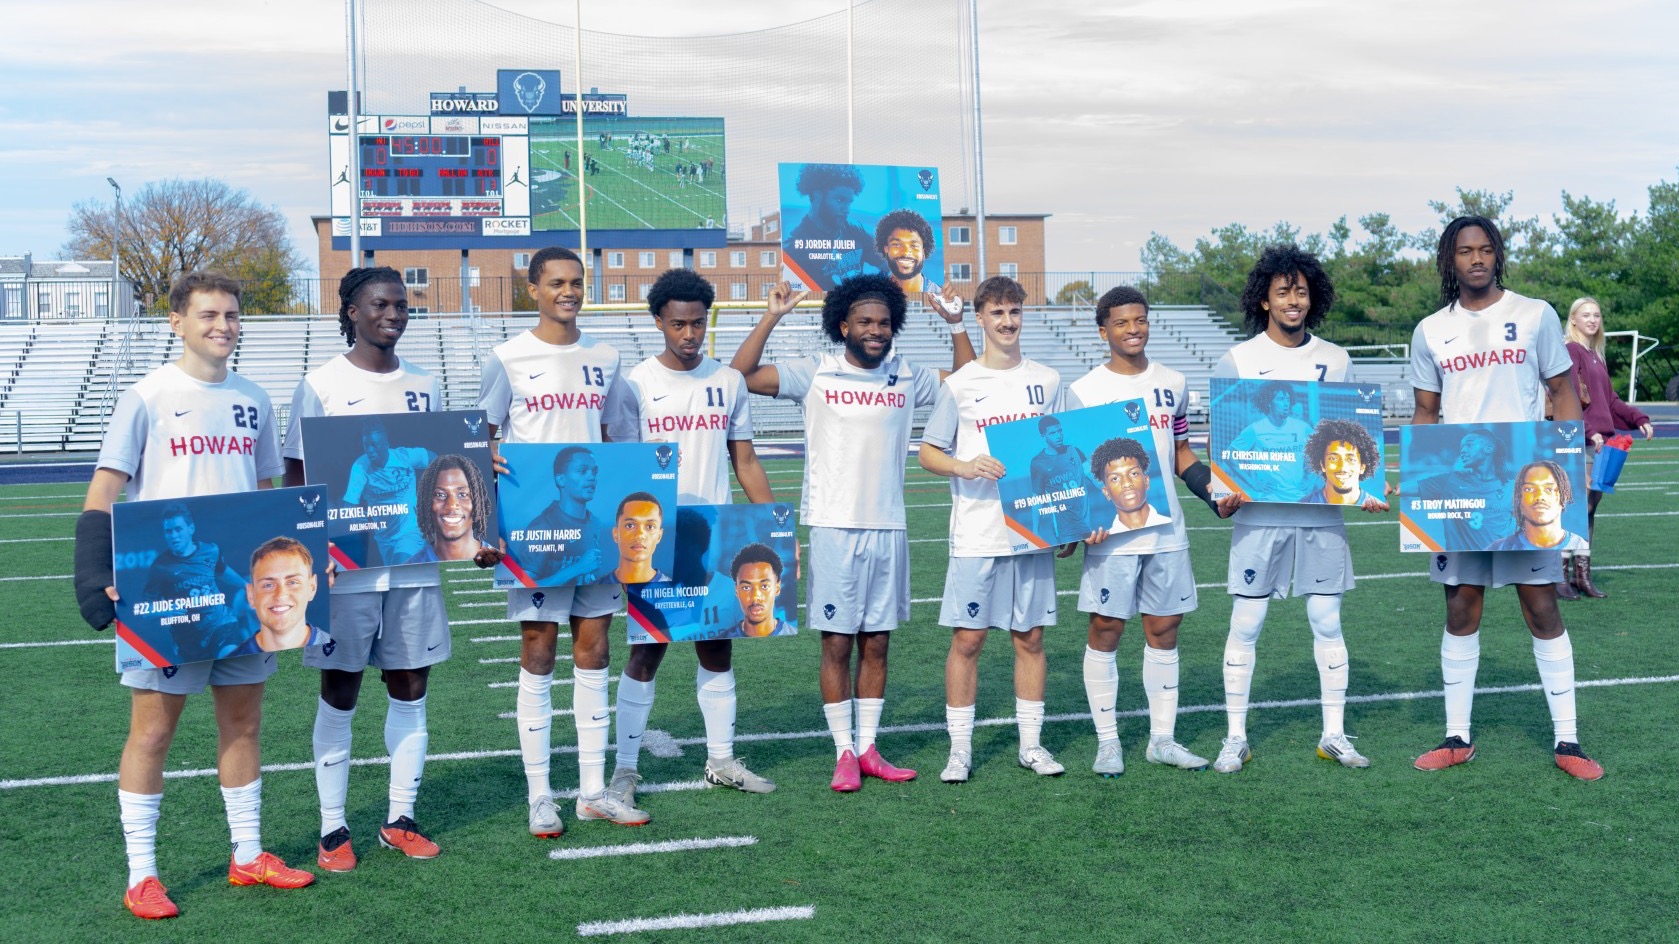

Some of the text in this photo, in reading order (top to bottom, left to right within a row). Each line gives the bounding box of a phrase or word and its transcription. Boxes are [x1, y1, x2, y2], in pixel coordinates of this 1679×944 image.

[431, 99, 627, 113] HOWARD UNVERSITY
[398, 120, 425, 129] pepsi
[376, 148, 386, 165] 0
[487, 149, 497, 165] 0
[485, 220, 528, 229] ROCKET
[794, 239, 856, 250] #9 JORDEN JULIEN
[808, 252, 835, 261] CHARLOTTE,
[1504, 322, 1517, 342] 3
[1440, 348, 1527, 375] HOWARD
[582, 365, 605, 387] 13
[1315, 363, 1328, 382] 7
[405, 390, 431, 412] 27
[706, 386, 725, 407] 11
[825, 389, 906, 409] HOWARD
[1026, 384, 1045, 405] 10
[1153, 388, 1175, 408] 19
[232, 404, 258, 431] 22
[647, 414, 729, 434] HOWARD
[170, 435, 257, 457] HOWAR
[1221, 450, 1297, 463] #7 CHRISTIAN RUFAEL
[1014, 486, 1086, 510] #19 ROMAN STALLINGS
[1411, 498, 1486, 511] #3 TROY MATINGOU
[339, 506, 366, 519] EZKIEL
[366, 503, 409, 517] AGYEMANG
[1447, 512, 1463, 520] ROCK,
[1463, 511, 1471, 519] TX
[296, 520, 325, 530] #BISON4LIFE
[349, 521, 387, 532] ARLINGTON, TX
[510, 528, 582, 541] #13 JUSTIN HARRIS
[528, 544, 565, 553] YPSILANTI, MI
[641, 585, 709, 599] #11 NIGEL MCCLOUD
[133, 593, 226, 616] #22 JUDE SPALLINGER
[688, 600, 695, 608] GA
[160, 613, 201, 626] BLUFFTON, OH
[703, 605, 720, 626] 11
